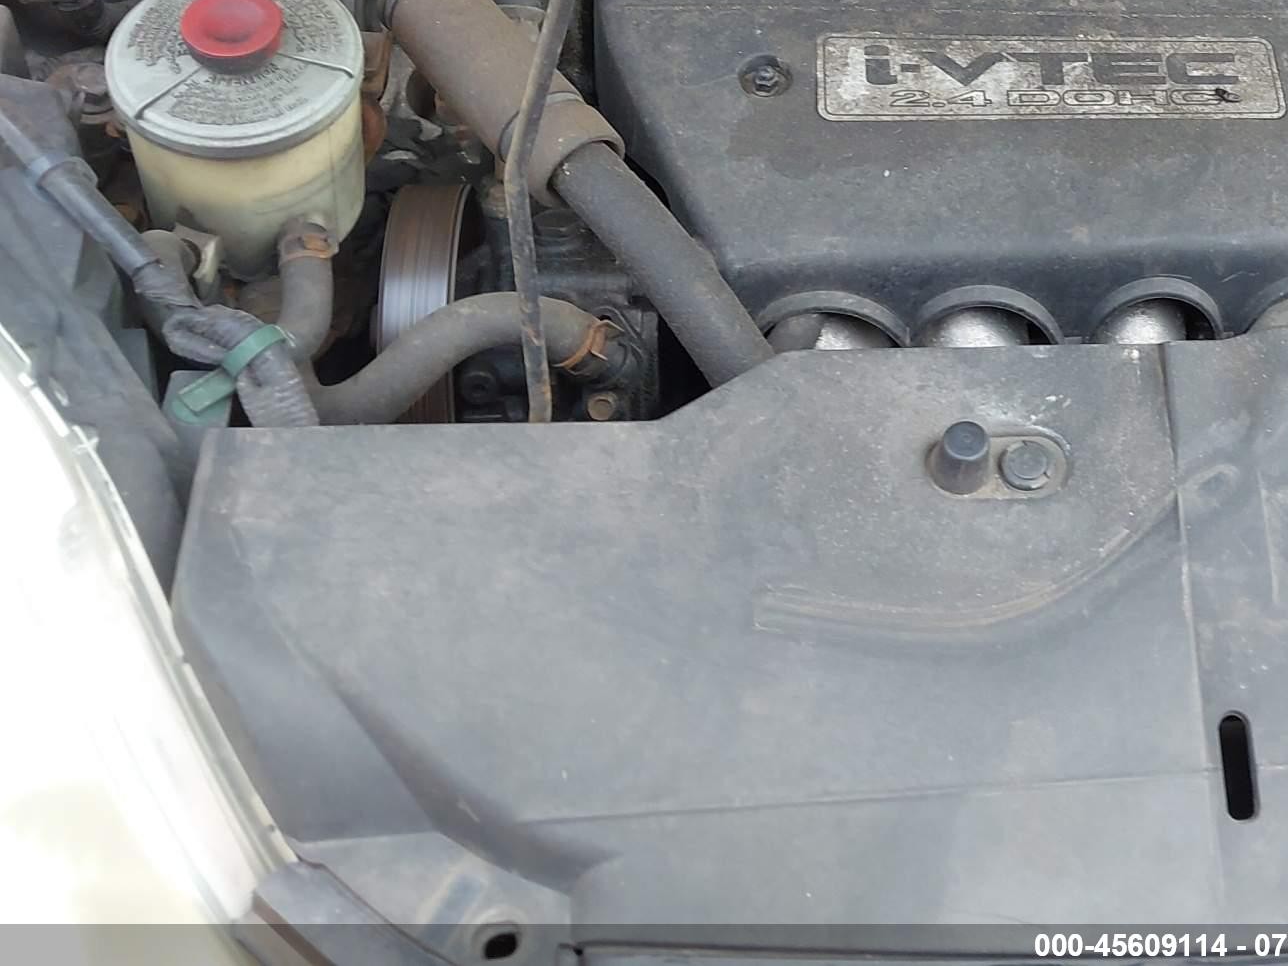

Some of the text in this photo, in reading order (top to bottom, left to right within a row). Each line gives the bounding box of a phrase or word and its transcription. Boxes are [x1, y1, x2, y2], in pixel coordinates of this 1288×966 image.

[864, 44, 1240, 86] i-VTEC
[889, 89, 1241, 108] 2.4 DOHC
